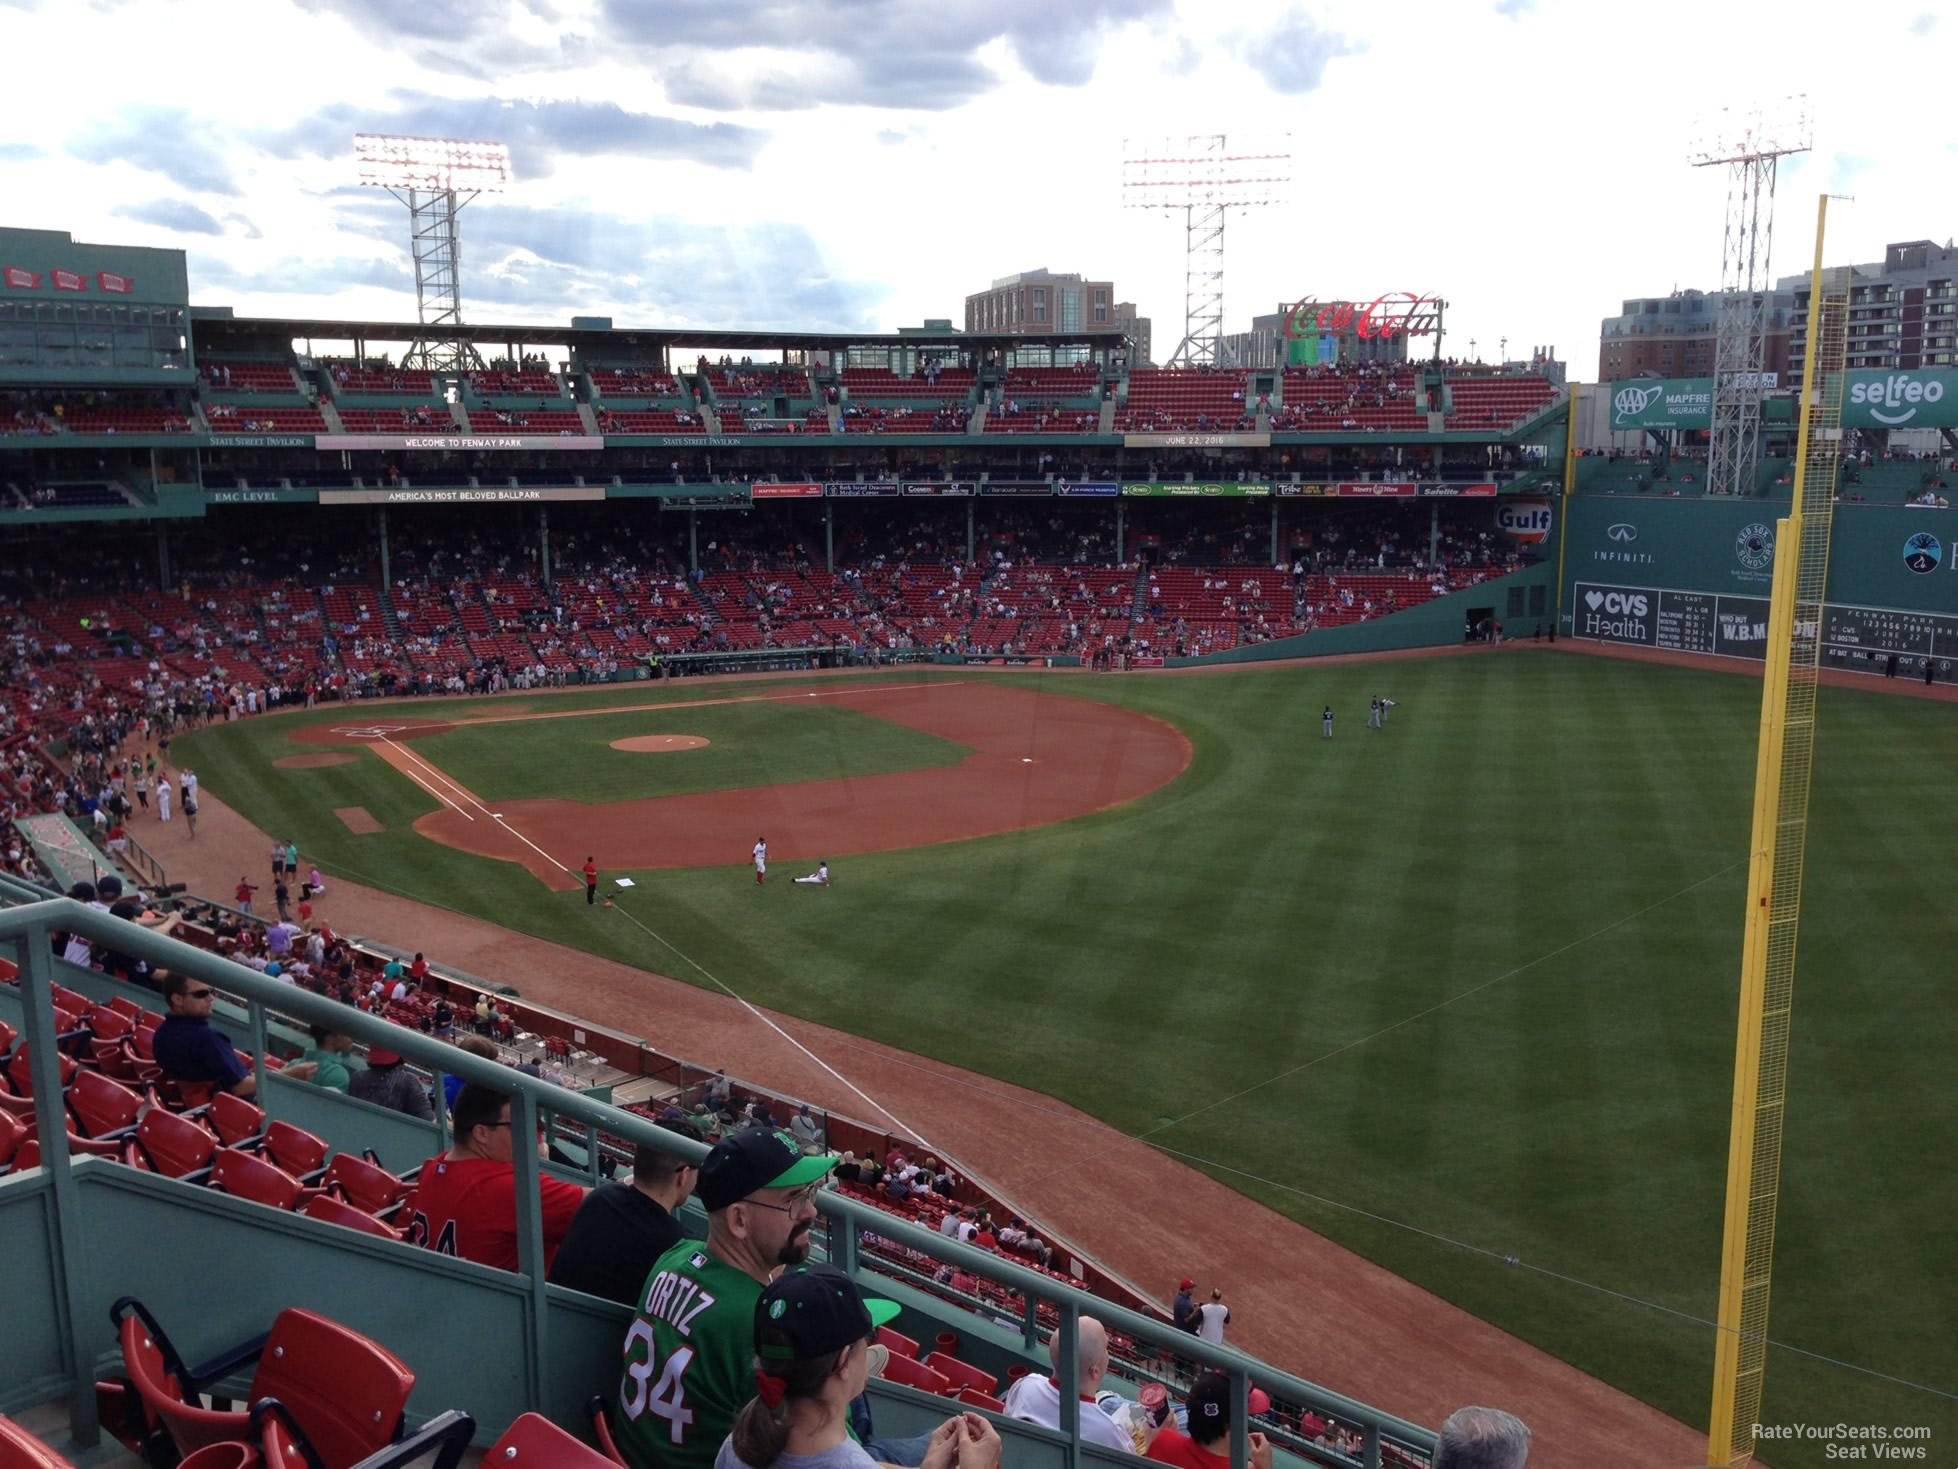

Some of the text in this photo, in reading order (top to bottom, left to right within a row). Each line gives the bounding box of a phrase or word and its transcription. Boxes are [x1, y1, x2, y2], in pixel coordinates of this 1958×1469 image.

[1665, 393, 1711, 404] MAPFRE
[1667, 407, 1708, 415] INSURANCE
[405, 439, 522, 448] WELCOME TO FENWAY PARK
[1165, 436, 1224, 445] JUNE 22, 2016
[1278, 484, 1301, 495] Tribe
[1352, 486, 1372, 494] Ninety
[215, 492, 278, 502] EMC LEVEL
[388, 491, 541, 501] AMERICA'S MOST BELOVED BALLPARK
[1499, 507, 1551, 529] Gulf
[1593, 550, 1652, 564] INFINITI
[1684, 595, 1703, 603] EAST
[1604, 592, 1648, 617] CVS
[1561, 614, 1572, 623] 310
[1719, 614, 1734, 623] WHO
[1847, 610, 1935, 625] FENWAY PARK
[1585, 613, 1647, 640] Health
[1842, 626, 1856, 634] CWS
[1837, 634, 1860, 643] BOSTON
[1828, 648, 1837, 656] AT
[1852, 651, 1869, 660] BALL
[1898, 656, 1914, 665] OUT
[645, 1270, 715, 1336] ORTIZ
[620, 1317, 694, 1445] 34
